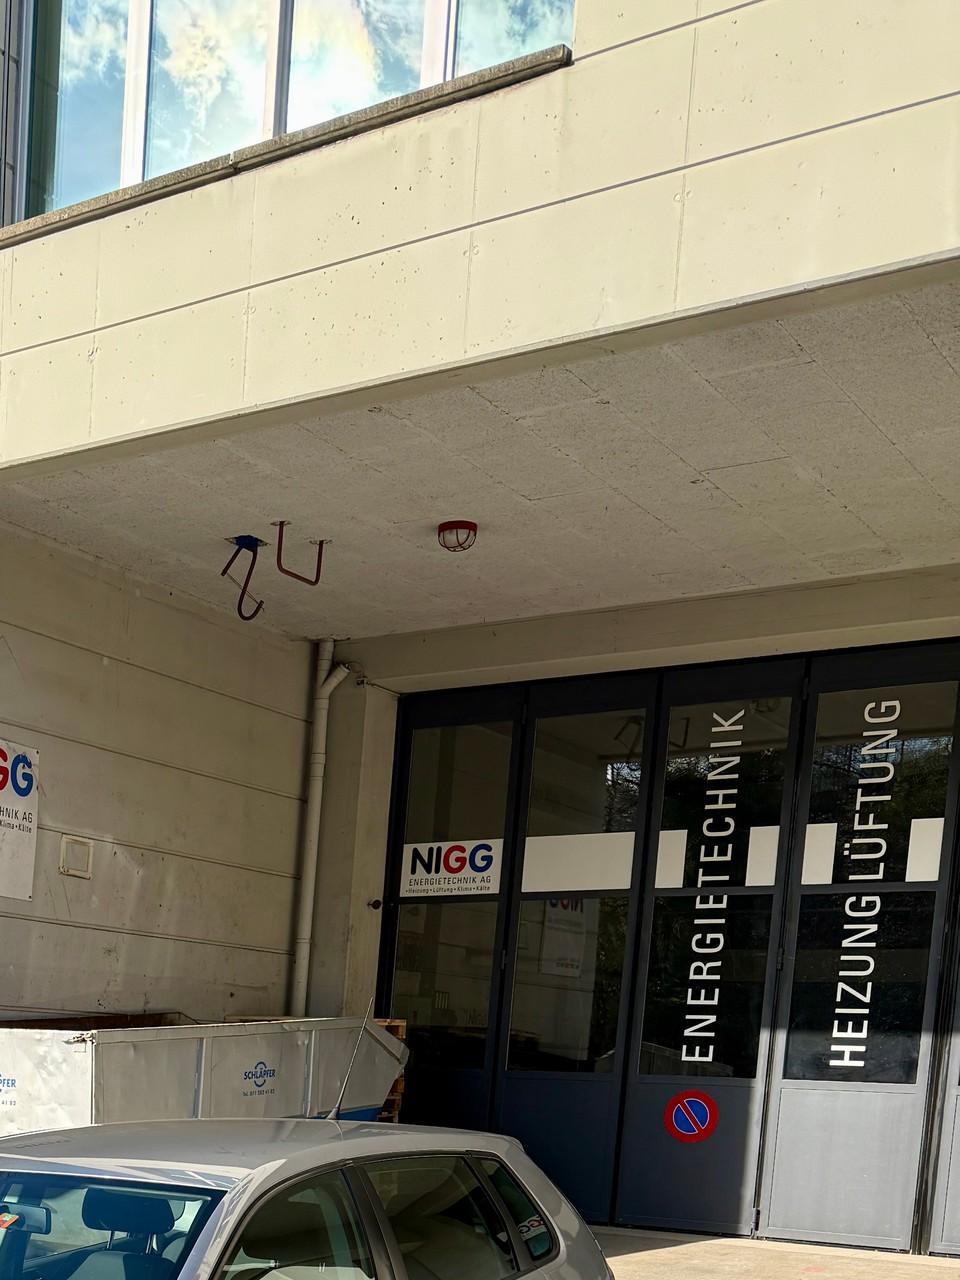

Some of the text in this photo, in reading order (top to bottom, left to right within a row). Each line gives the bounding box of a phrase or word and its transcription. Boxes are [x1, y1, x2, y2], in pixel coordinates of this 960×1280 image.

[21, 811, 33, 824] AG
[410, 843, 494, 875] NIGG
[409, 876, 491, 887] ENERGIETECHNIK AG
[681, 708, 746, 1063] ENERGIETECHNIK
[829, 699, 901, 1068] HEIZUNG LÜFTUNG
[243, 1068, 276, 1080] SCHLÄPFER
